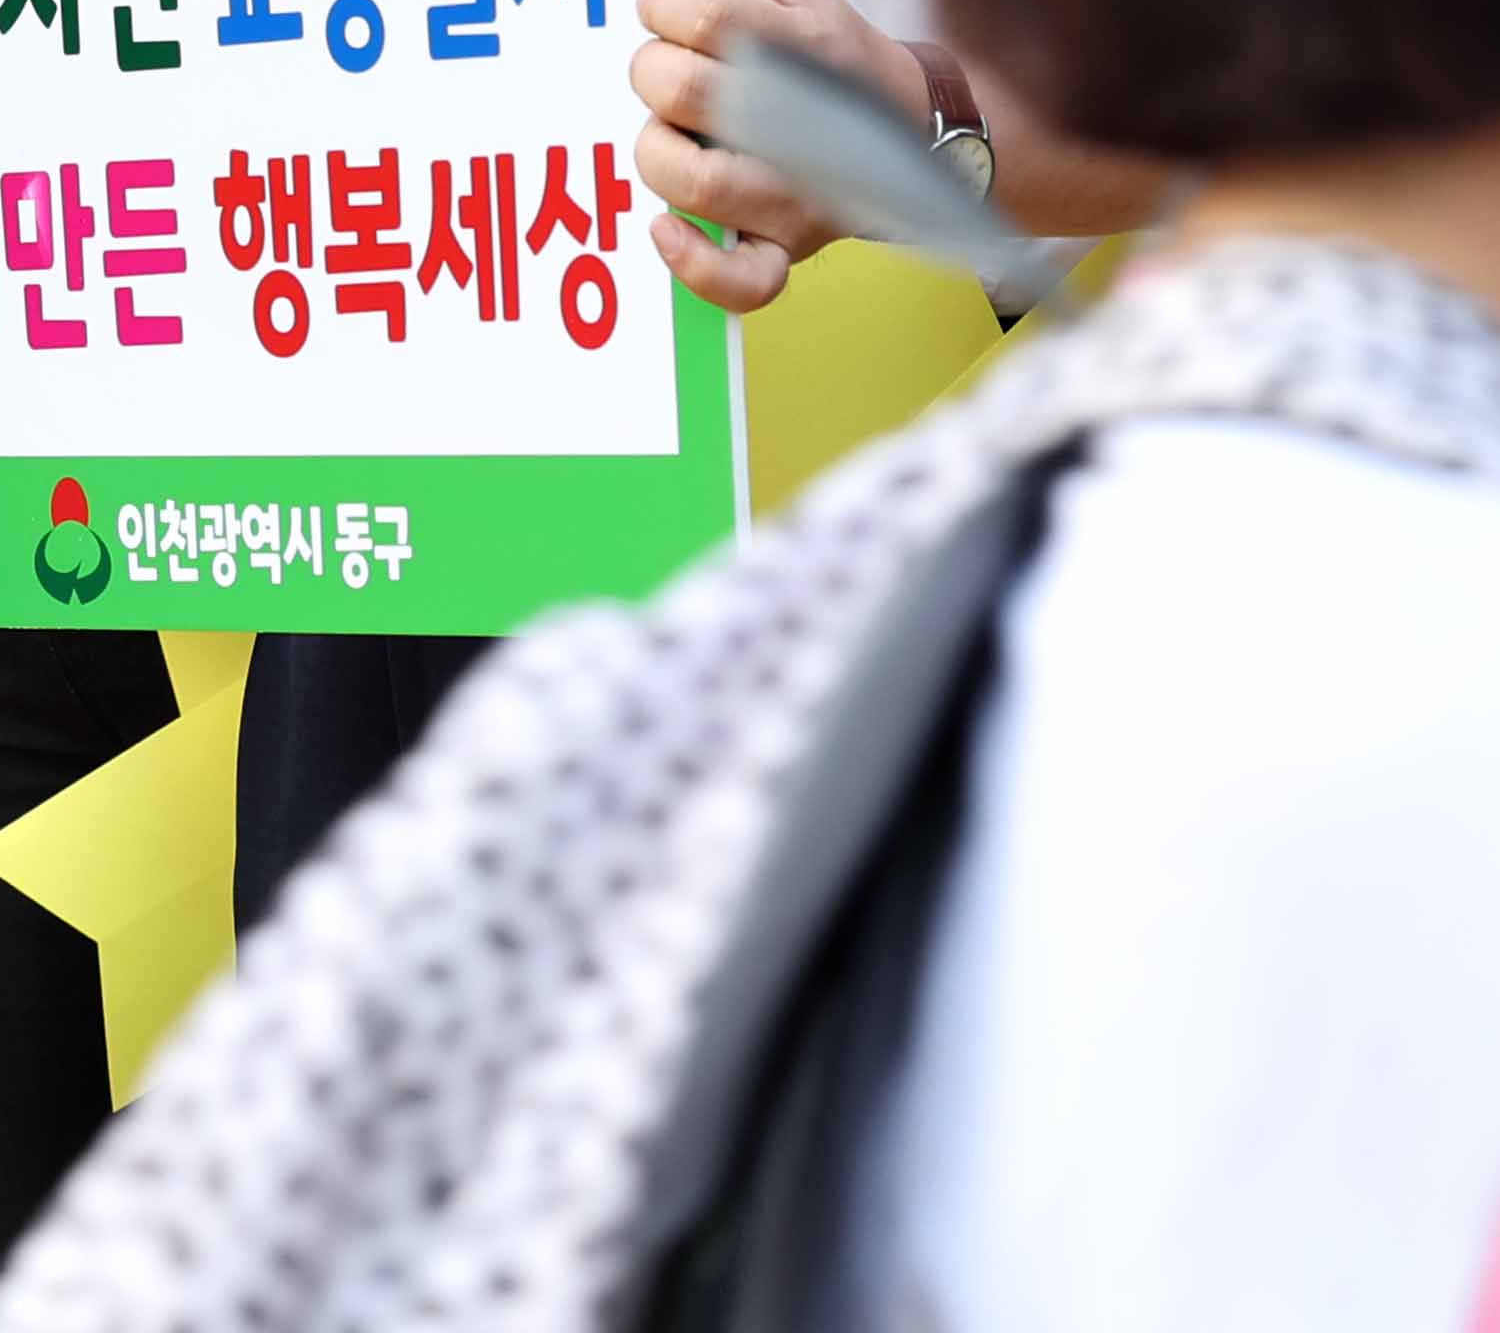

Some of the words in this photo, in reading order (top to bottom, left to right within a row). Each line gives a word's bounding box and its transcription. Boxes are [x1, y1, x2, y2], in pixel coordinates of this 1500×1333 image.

[212, 143, 633, 359] 행복세상
[116, 499, 325, 587] 인천광역시
[331, 503, 413, 590] 동구
